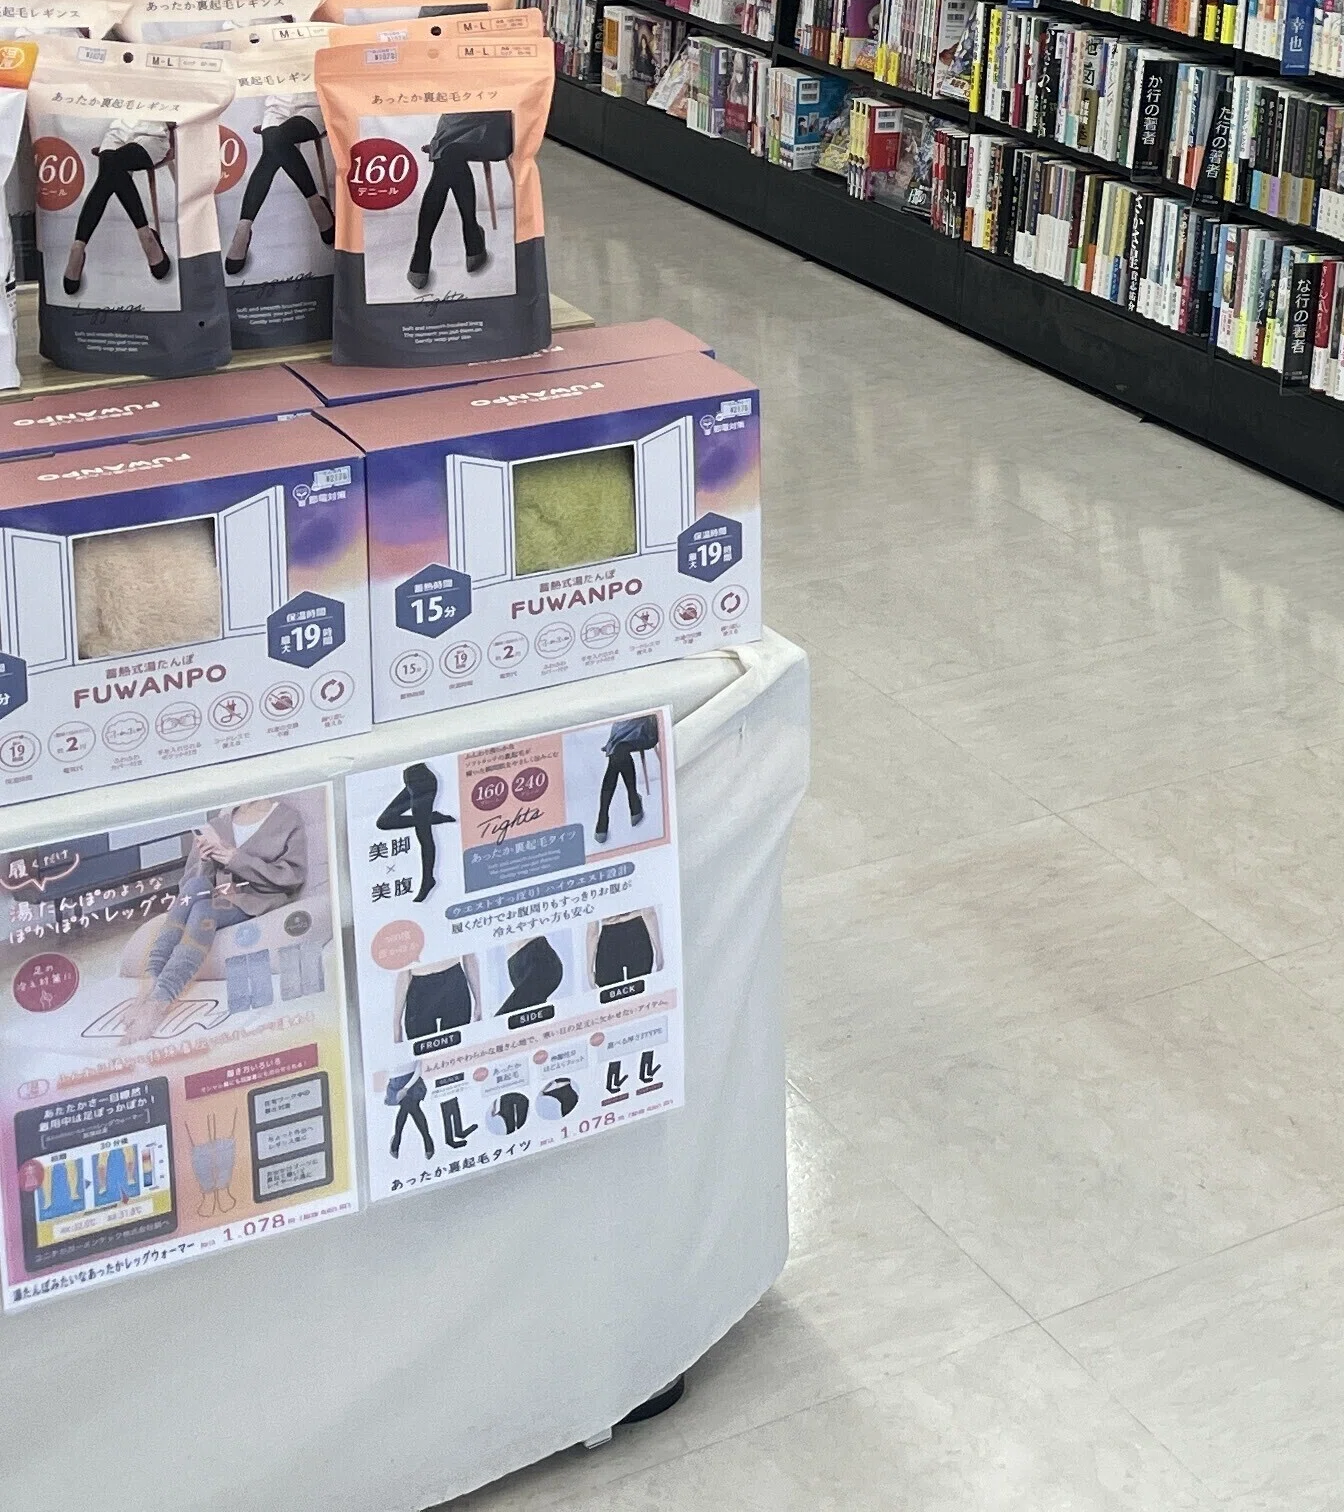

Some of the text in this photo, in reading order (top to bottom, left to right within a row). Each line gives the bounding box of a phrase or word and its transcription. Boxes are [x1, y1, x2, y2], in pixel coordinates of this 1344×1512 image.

[1288, 15, 1305, 54] 幸也
[51, 90, 181, 114] あったか裏起毛レギンス
[371, 89, 498, 105] あったか裏起毛タイツ
[1141, 74, 1164, 147] か行の著者
[1204, 106, 1233, 180] た行の著者
[351, 153, 411, 183] 160
[357, 186, 399, 197] デニール
[1290, 277, 1313, 355] な行の著者
[410, 597, 457, 624] 15分
[511, 579, 643, 620] FUWANPO
[73, 664, 227, 709] FUWANPO
[475, 783, 506, 800] 160
[514, 773, 546, 793] 240
[477, 807, 546, 845] Tights
[368, 836, 412, 861] 美脚
[471, 830, 577, 863] あったか裏起毛タイツ
[9, 877, 163, 923] 湯たんぽのような
[371, 876, 414, 902] 美腹
[9, 880, 251, 944] ぽかぽかレッグウォーマー
[451, 880, 633, 933] 履くだけでお腹周りもすっきりお腹が
[493, 904, 595, 938] 冷えやすい方も安心
[609, 985, 636, 999] BACK
[519, 1010, 544, 1024] SIDE
[419, 1034, 455, 1052] FRONT
[391, 1139, 531, 1192] あったか裏起毛タイツ
